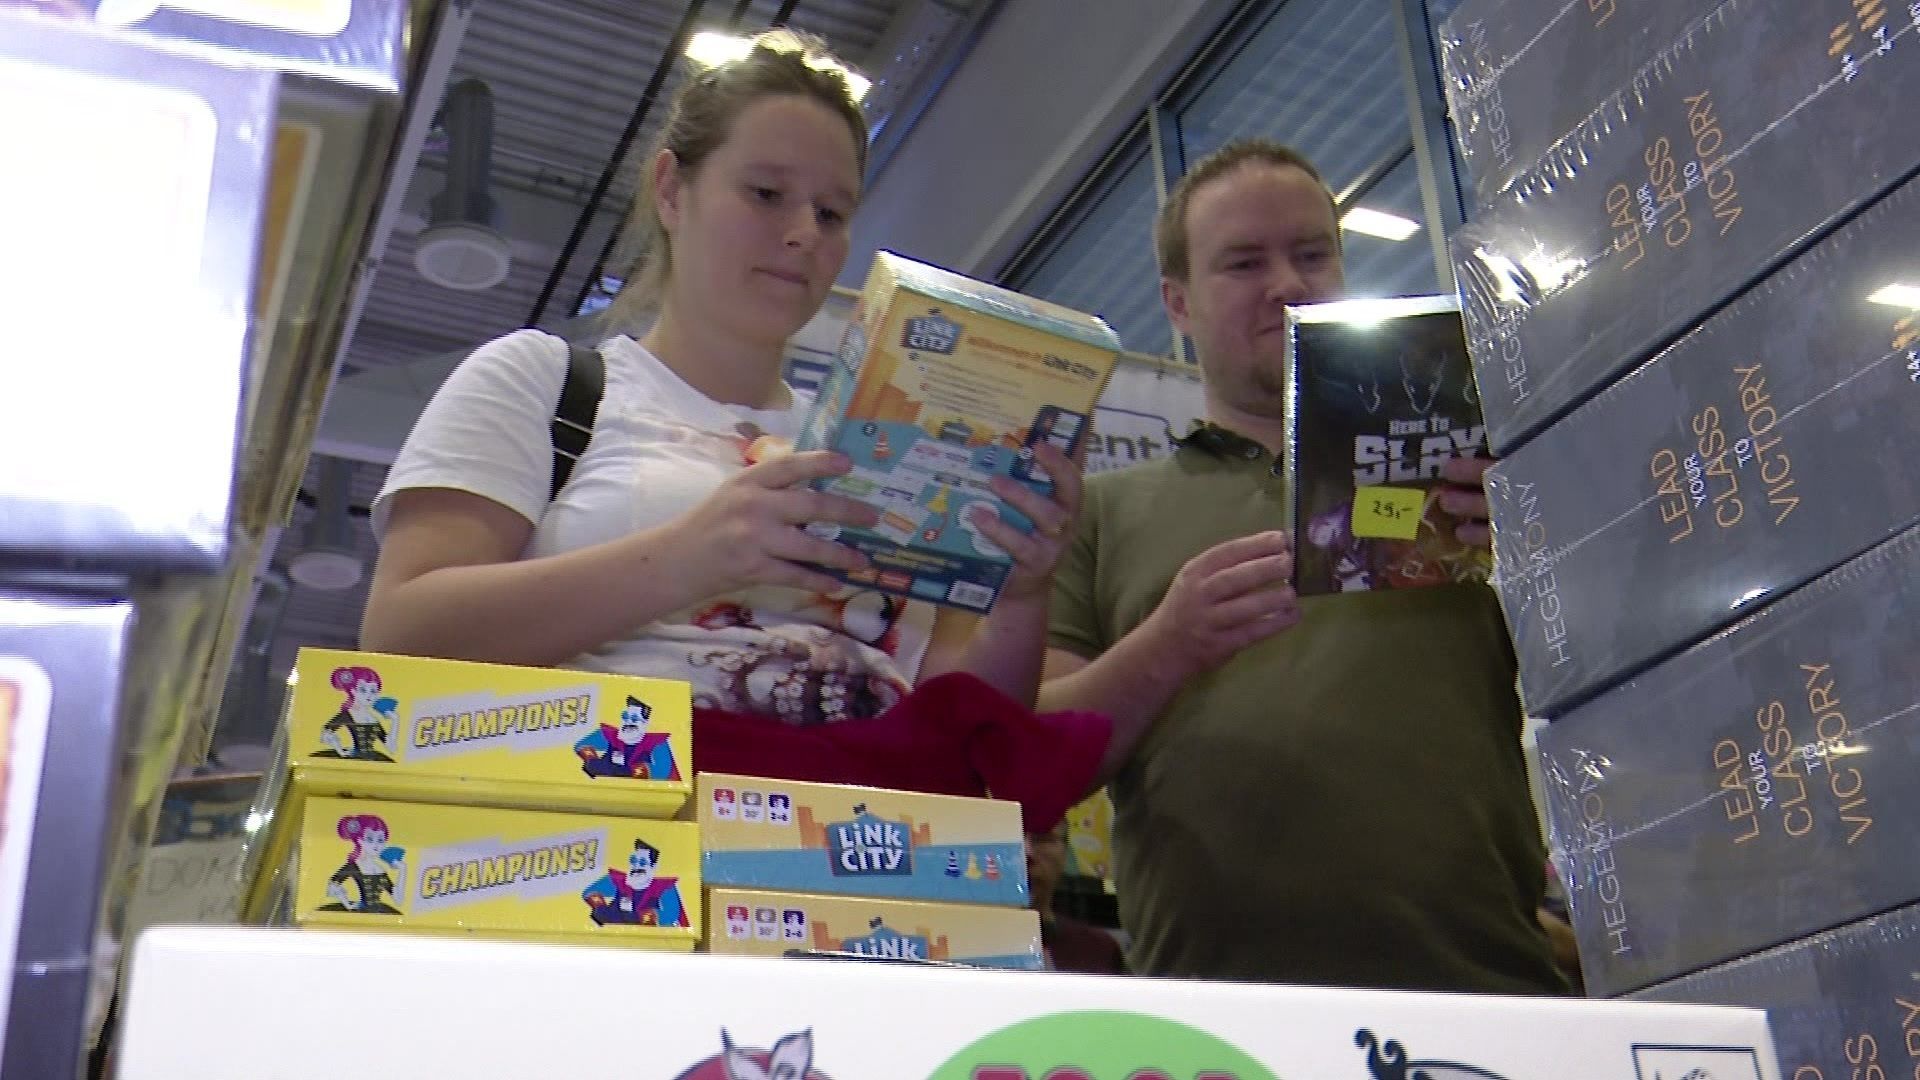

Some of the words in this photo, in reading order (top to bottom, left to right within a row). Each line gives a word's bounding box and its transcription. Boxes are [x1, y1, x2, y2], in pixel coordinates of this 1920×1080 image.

[1645, 136, 1691, 247] CLASS
[1684, 90, 1742, 236] VICTORY
[1684, 161, 1701, 190] TO
[1606, 184, 1644, 271] LEAD
[1636, 182, 1657, 233] YOUR
[1353, 425, 1484, 487] SLAY
[1693, 406, 1743, 528] CLASS
[1734, 362, 1799, 525] VICTORY
[1734, 436, 1752, 469] TO
[1651, 449, 1693, 543] LEAD
[1684, 453, 1706, 509] YOUR
[413, 694, 591, 749] CHAMPIONS!
[1799, 663, 1872, 845] VICTORY
[1803, 741, 1820, 774] TO
[1713, 739, 1760, 845] LEAD
[1749, 751, 1774, 810] YOUR
[1757, 701, 1813, 837] CLASS
[421, 839, 599, 899] CHAMPIONS!
